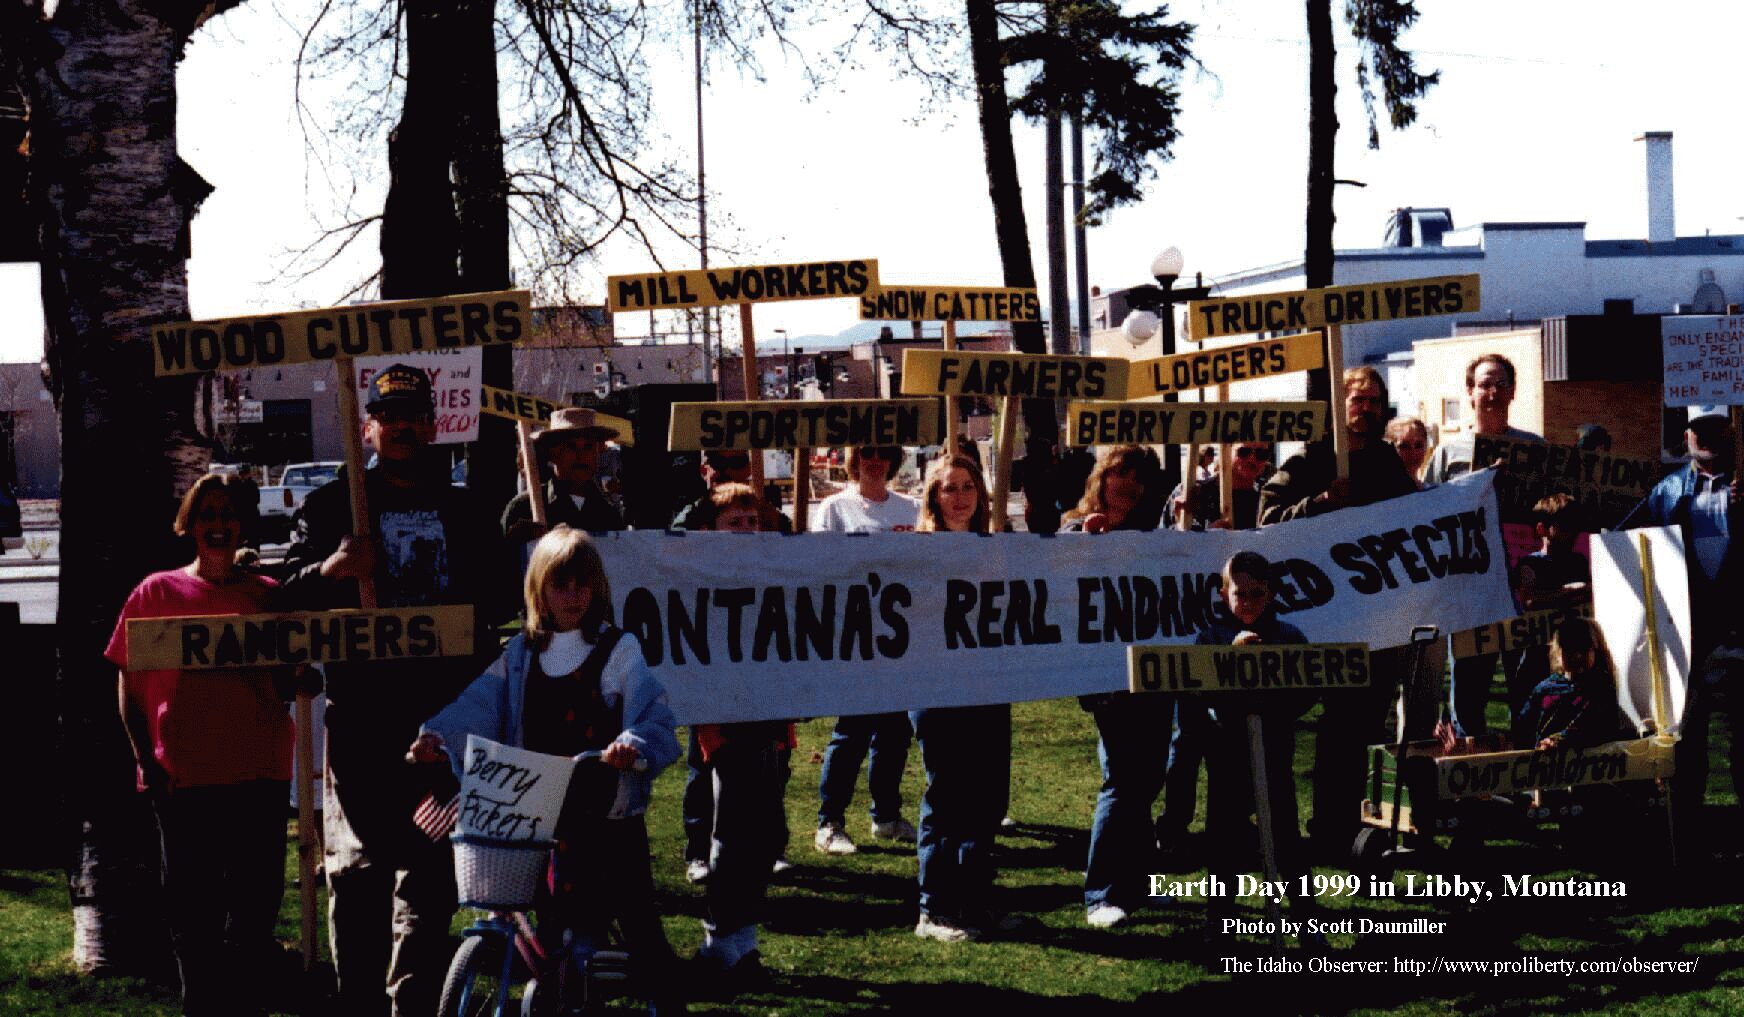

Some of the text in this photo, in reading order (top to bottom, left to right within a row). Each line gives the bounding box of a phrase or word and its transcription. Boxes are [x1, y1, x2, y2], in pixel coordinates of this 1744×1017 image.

[618, 260, 869, 307] MILL WORKERS
[861, 292, 1041, 321] SNOW CATTERS
[1199, 281, 1464, 334] TRUCK DRIVERS
[156, 300, 523, 371] WOOD CUTTERS
[450, 365, 471, 379] and
[938, 358, 1106, 397] FARMERS
[1153, 343, 1286, 392] LOGGERS
[480, 387, 553, 421] INER
[1669, 385, 1700, 398] MEN
[700, 406, 920, 450] SPORTSMEN
[1078, 410, 1314, 444] BERRY PICKERS
[622, 507, 1491, 667] ONTANA'S REAL ENDANGED SPECIES
[181, 614, 438, 667] RANCHERS
[1139, 647, 1369, 690] OIL WORKERS
[470, 748, 543, 805] Berry
[1450, 746, 1627, 793] Our Children
